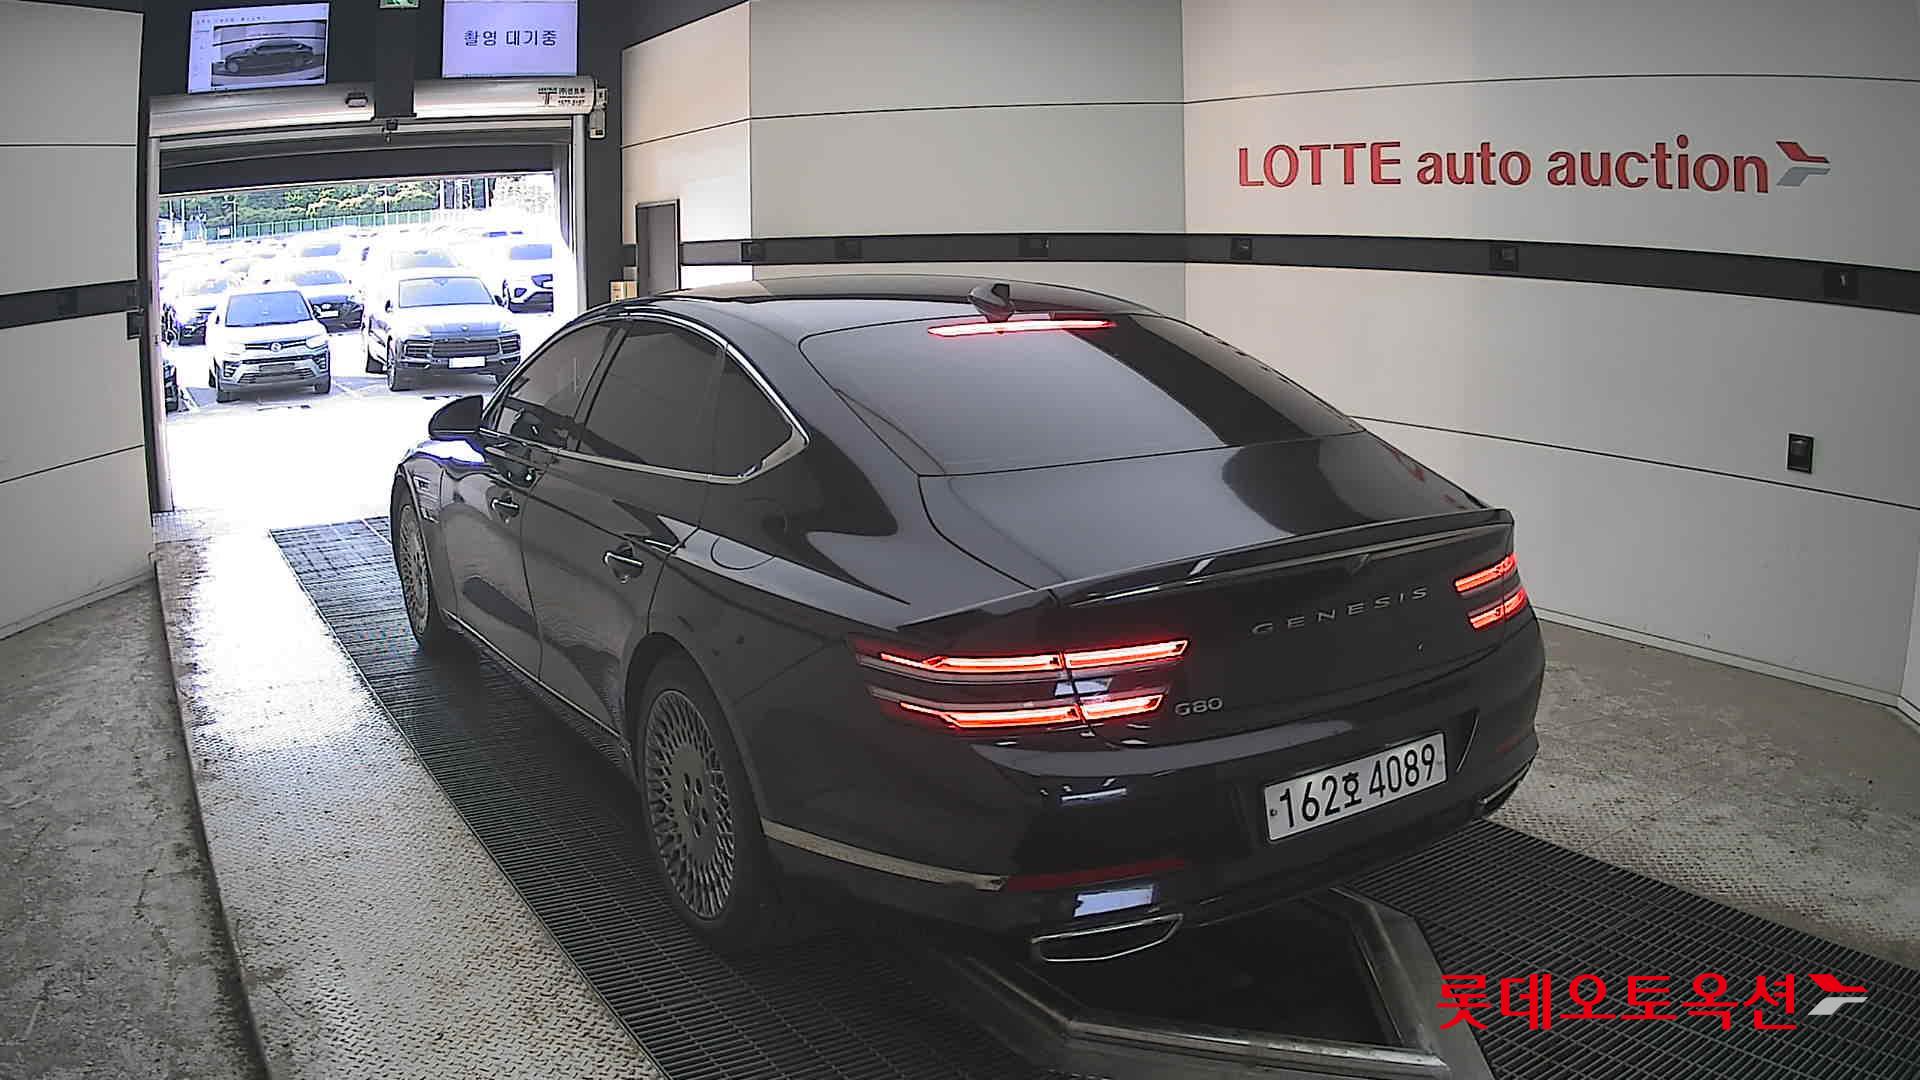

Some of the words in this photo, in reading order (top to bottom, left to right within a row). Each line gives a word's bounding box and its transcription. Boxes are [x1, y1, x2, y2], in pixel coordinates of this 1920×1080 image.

[463, 30, 497, 46] 촬영
[506, 30, 557, 46] 대기중
[1238, 140, 1401, 187] LOTTE
[1417, 142, 1531, 186] auto
[1547, 135, 1768, 194] auction
[1253, 587, 1427, 634] GENESIS
[1175, 697, 1223, 716] G80
[1280, 772, 1362, 828] 162호
[1369, 744, 1435, 798] 4089
